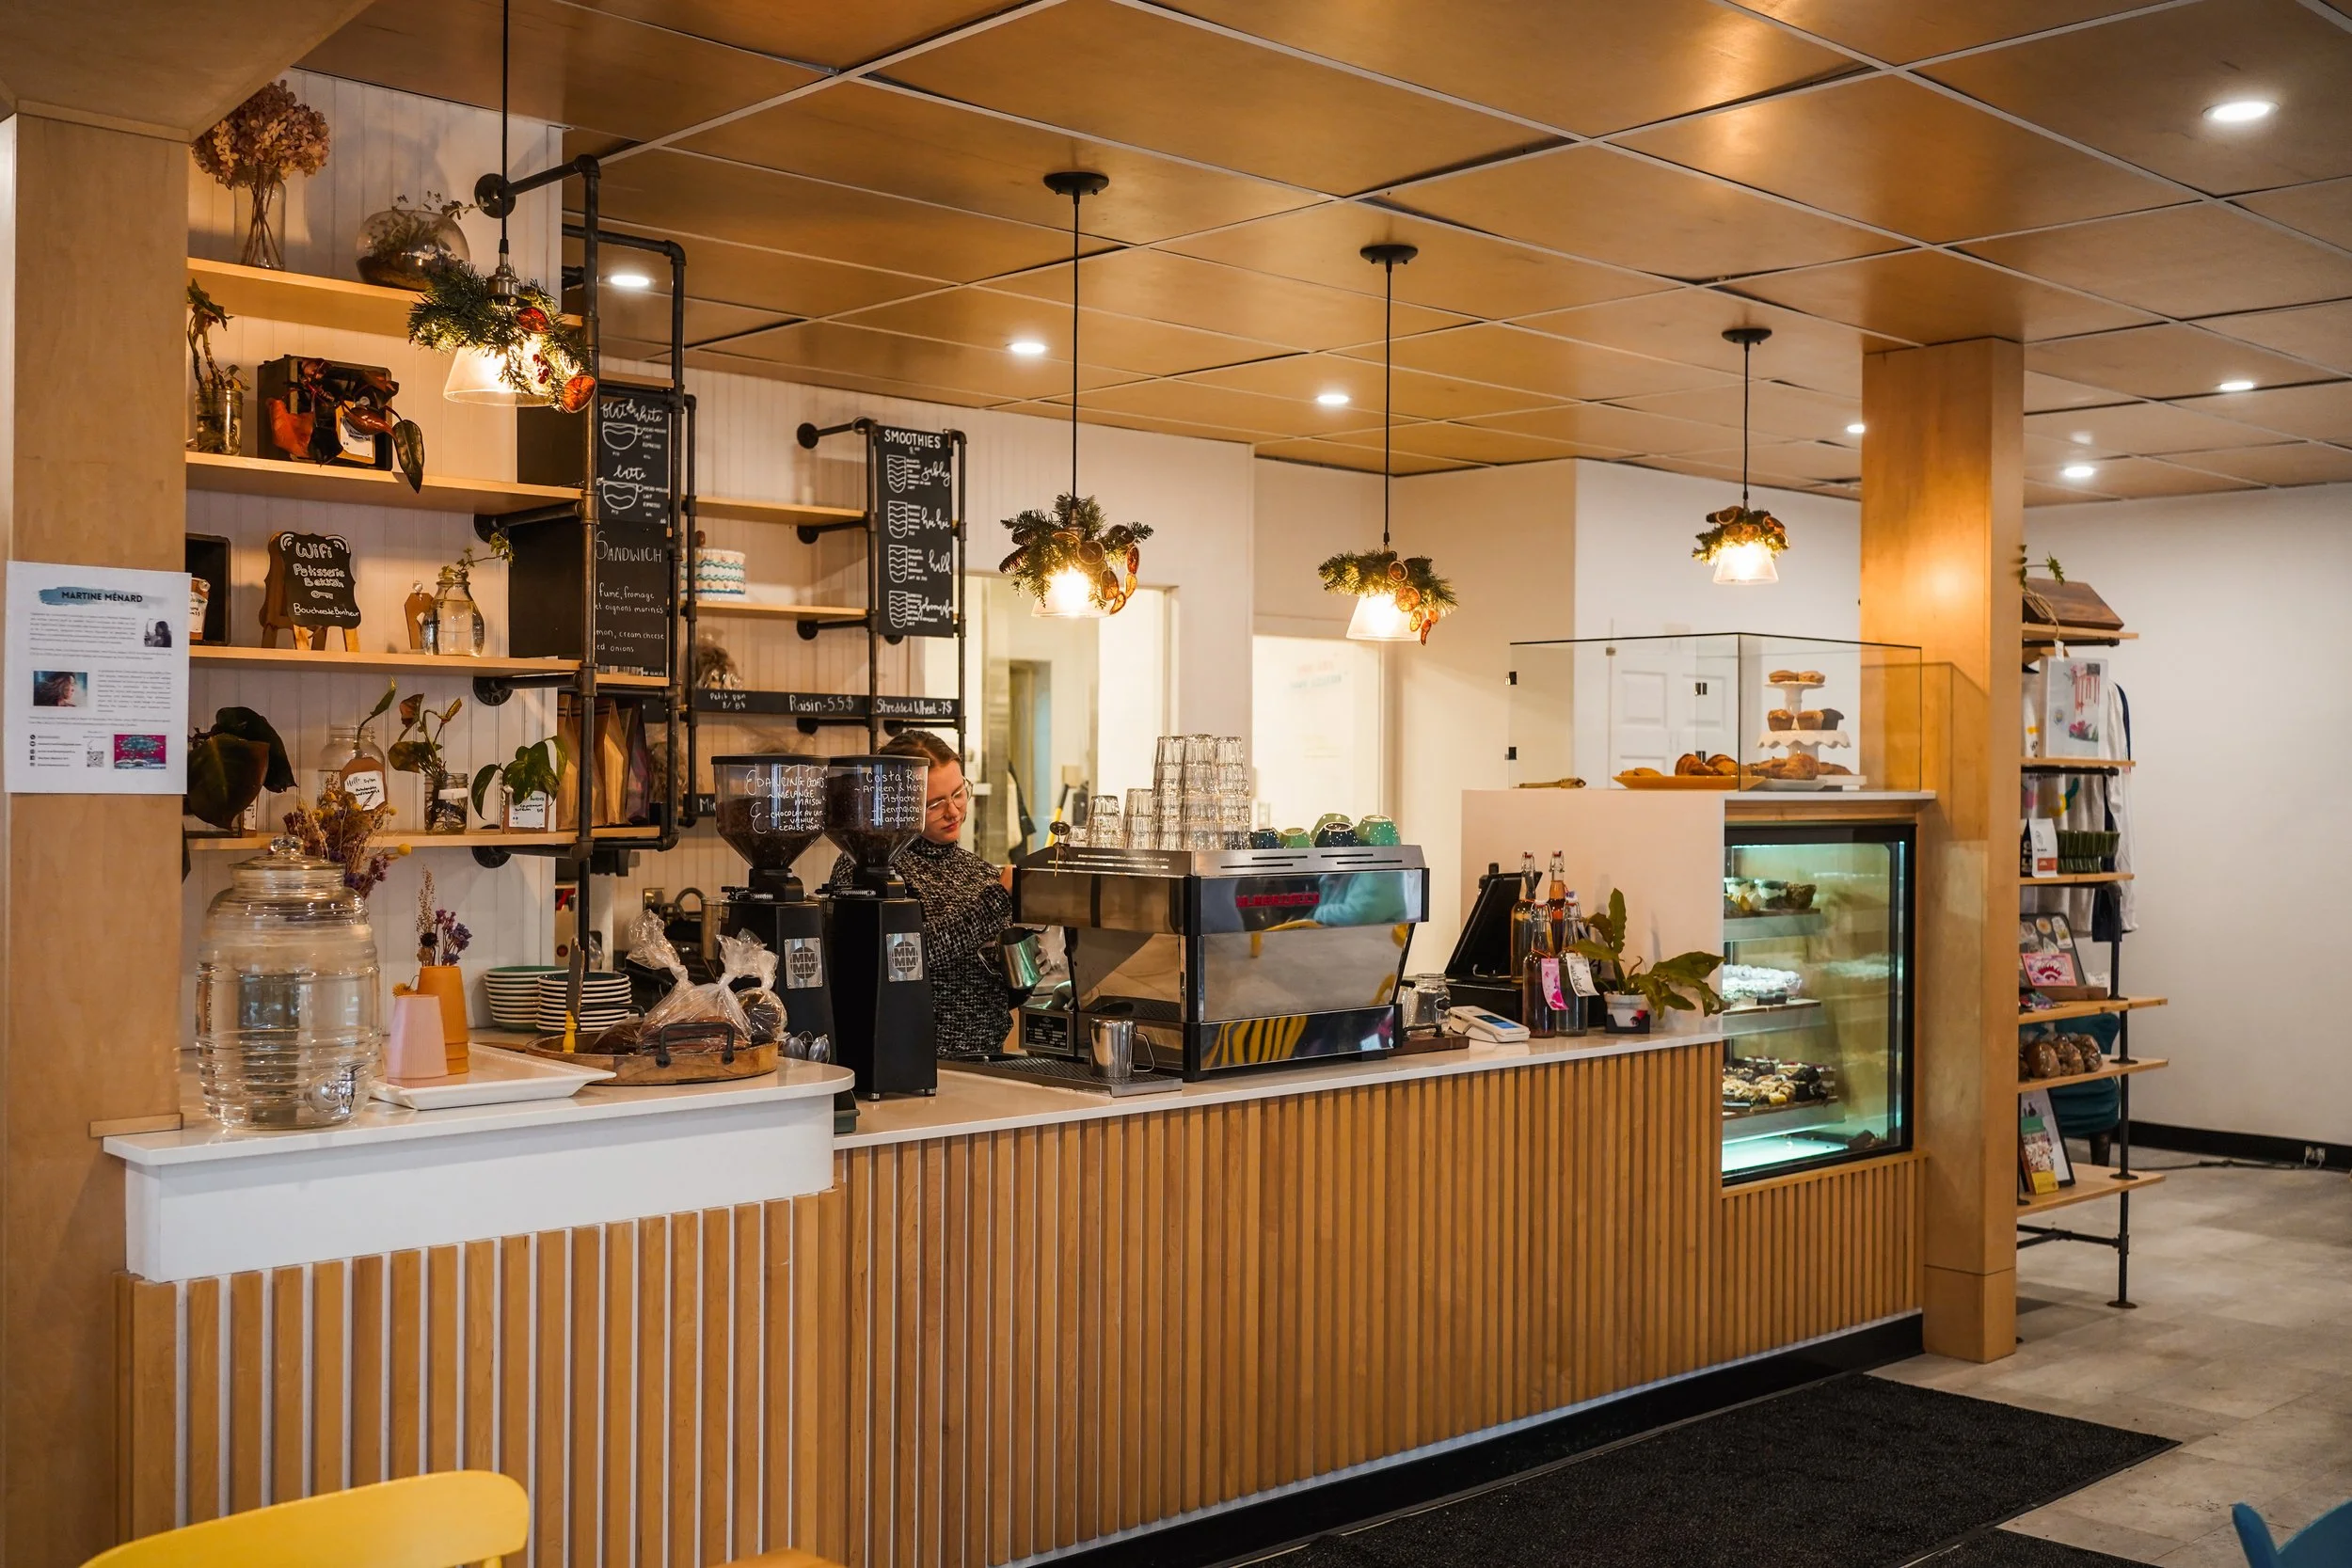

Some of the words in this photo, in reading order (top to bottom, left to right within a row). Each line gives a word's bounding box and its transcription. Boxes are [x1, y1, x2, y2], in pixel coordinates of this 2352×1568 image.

[884, 429, 941, 449] SMOOTHIES
[613, 465, 646, 481] latte
[296, 543, 333, 559] Wifi
[596, 531, 662, 563] SANDWICH
[61, 592, 102, 601] MARTINE
[105, 593, 143, 603] MÉNARD
[624, 585, 655, 602] fromage
[605, 606, 631, 615] oignons
[596, 629, 617, 640] mon,
[876, 698, 913, 713] Shredded
[914, 700, 937, 715] Wheat
[756, 777, 804, 787] DANCING
[866, 770, 901, 784] Costa
[794, 798, 821, 806] MAISON
[881, 794, 915, 802] Pistache
